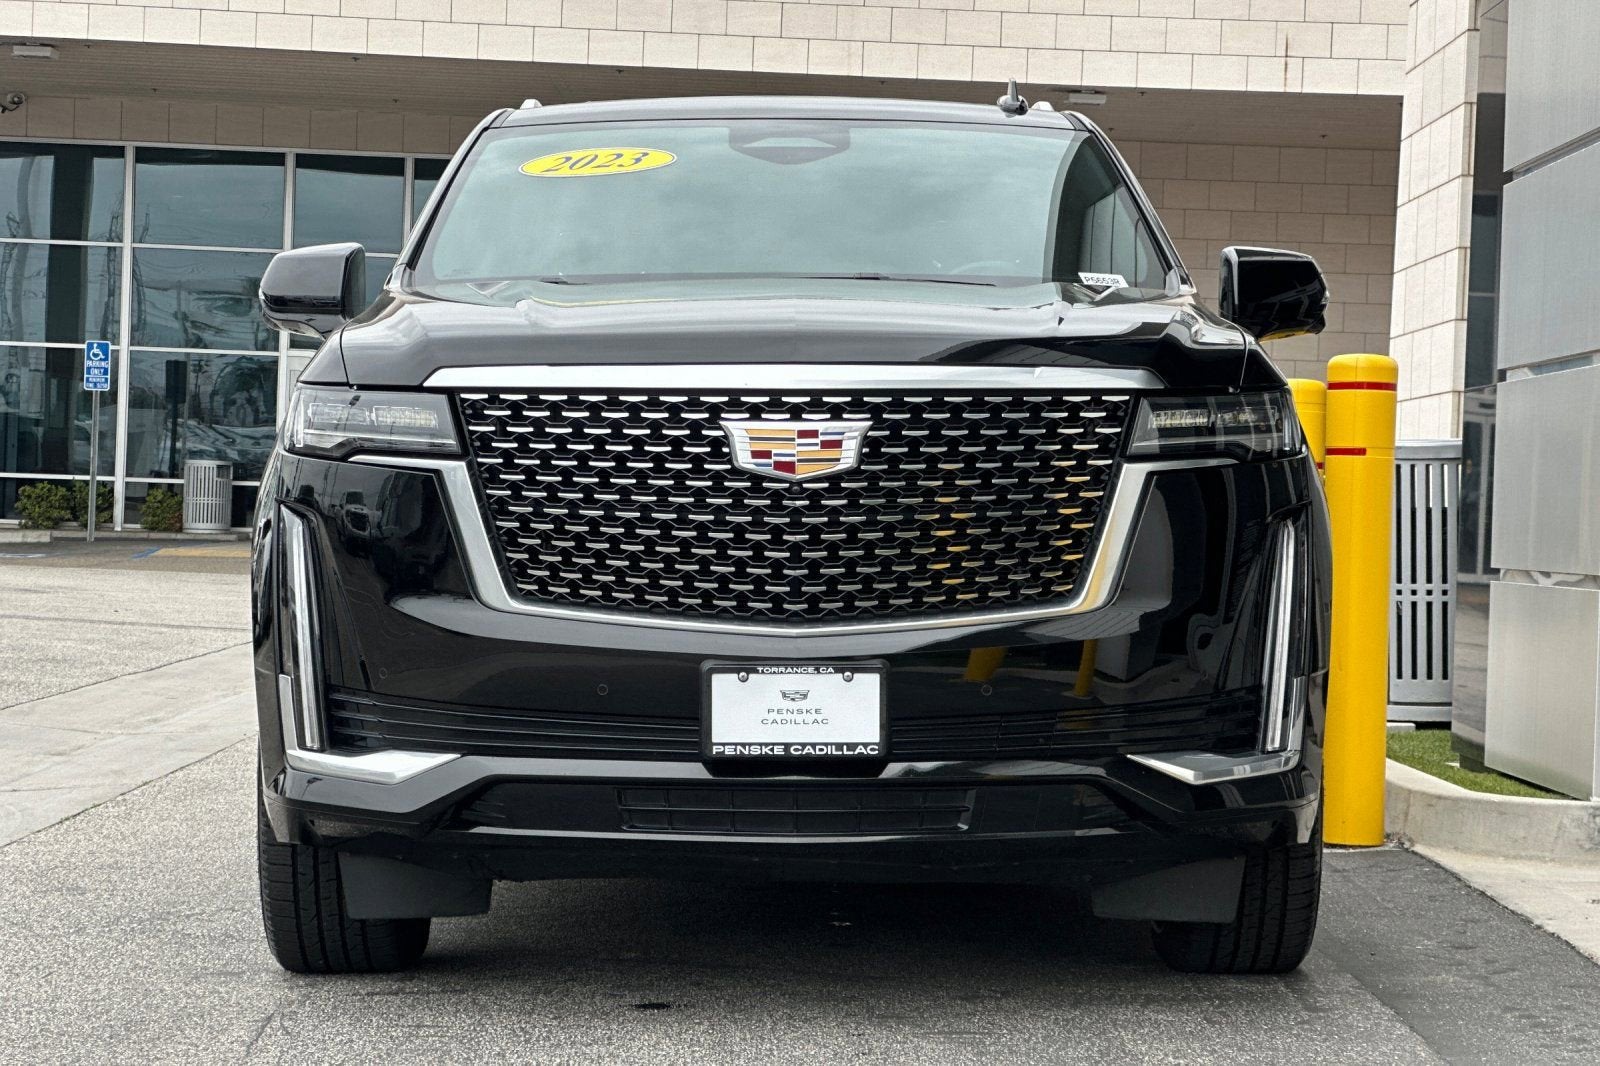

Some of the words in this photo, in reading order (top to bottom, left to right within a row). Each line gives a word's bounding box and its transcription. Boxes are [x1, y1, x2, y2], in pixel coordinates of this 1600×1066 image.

[540, 151, 650, 174] 2023
[86, 360, 109, 368] PARKING
[90, 368, 105, 376] ONLY
[756, 667, 818, 675] TORRANCE,
[712, 745, 786, 755] PENSKE
[789, 745, 879, 755] CADILLAC
